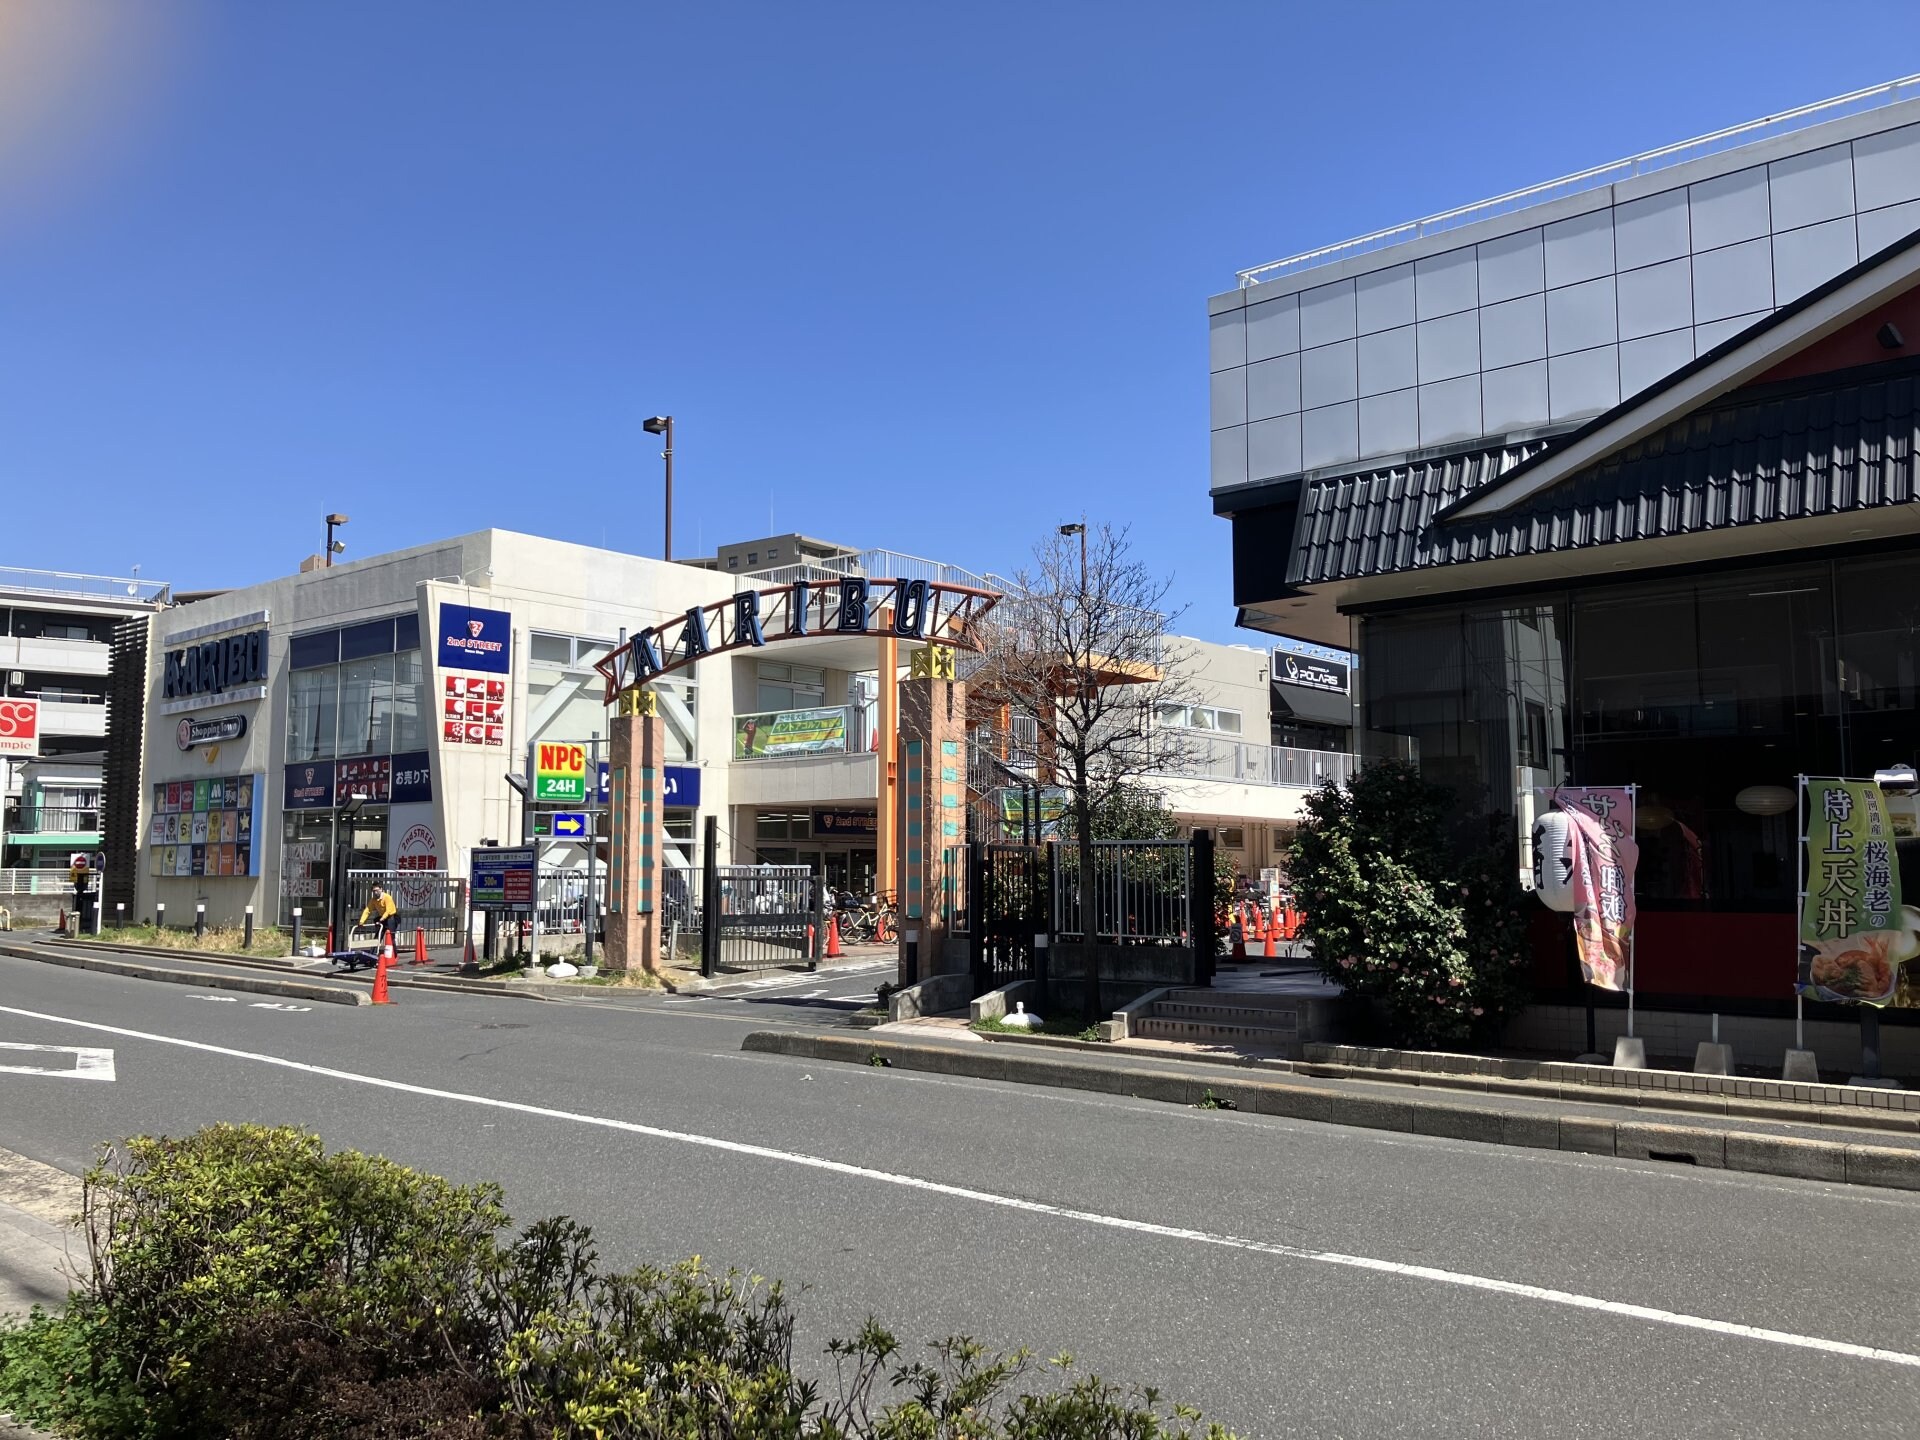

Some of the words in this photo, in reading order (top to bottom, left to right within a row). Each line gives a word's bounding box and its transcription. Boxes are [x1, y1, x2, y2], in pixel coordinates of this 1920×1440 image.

[629, 577, 931, 682] KARIBU
[447, 636, 466, 648] 2nd
[467, 638, 503, 652] STREET
[162, 629, 270, 699] KARIBU
[1299, 669, 1338, 686] POLARIS
[191, 722, 221, 738] Shopping
[221, 721, 238, 733] Town
[540, 744, 583, 772] NPC
[395, 769, 430, 785] お売り下
[546, 779, 576, 793] 24H
[401, 831, 413, 851] 2nd
[413, 828, 436, 849] STREET
[1818, 787, 1858, 939] 特上天丼
[1863, 840, 1892, 928] 桜海老の
